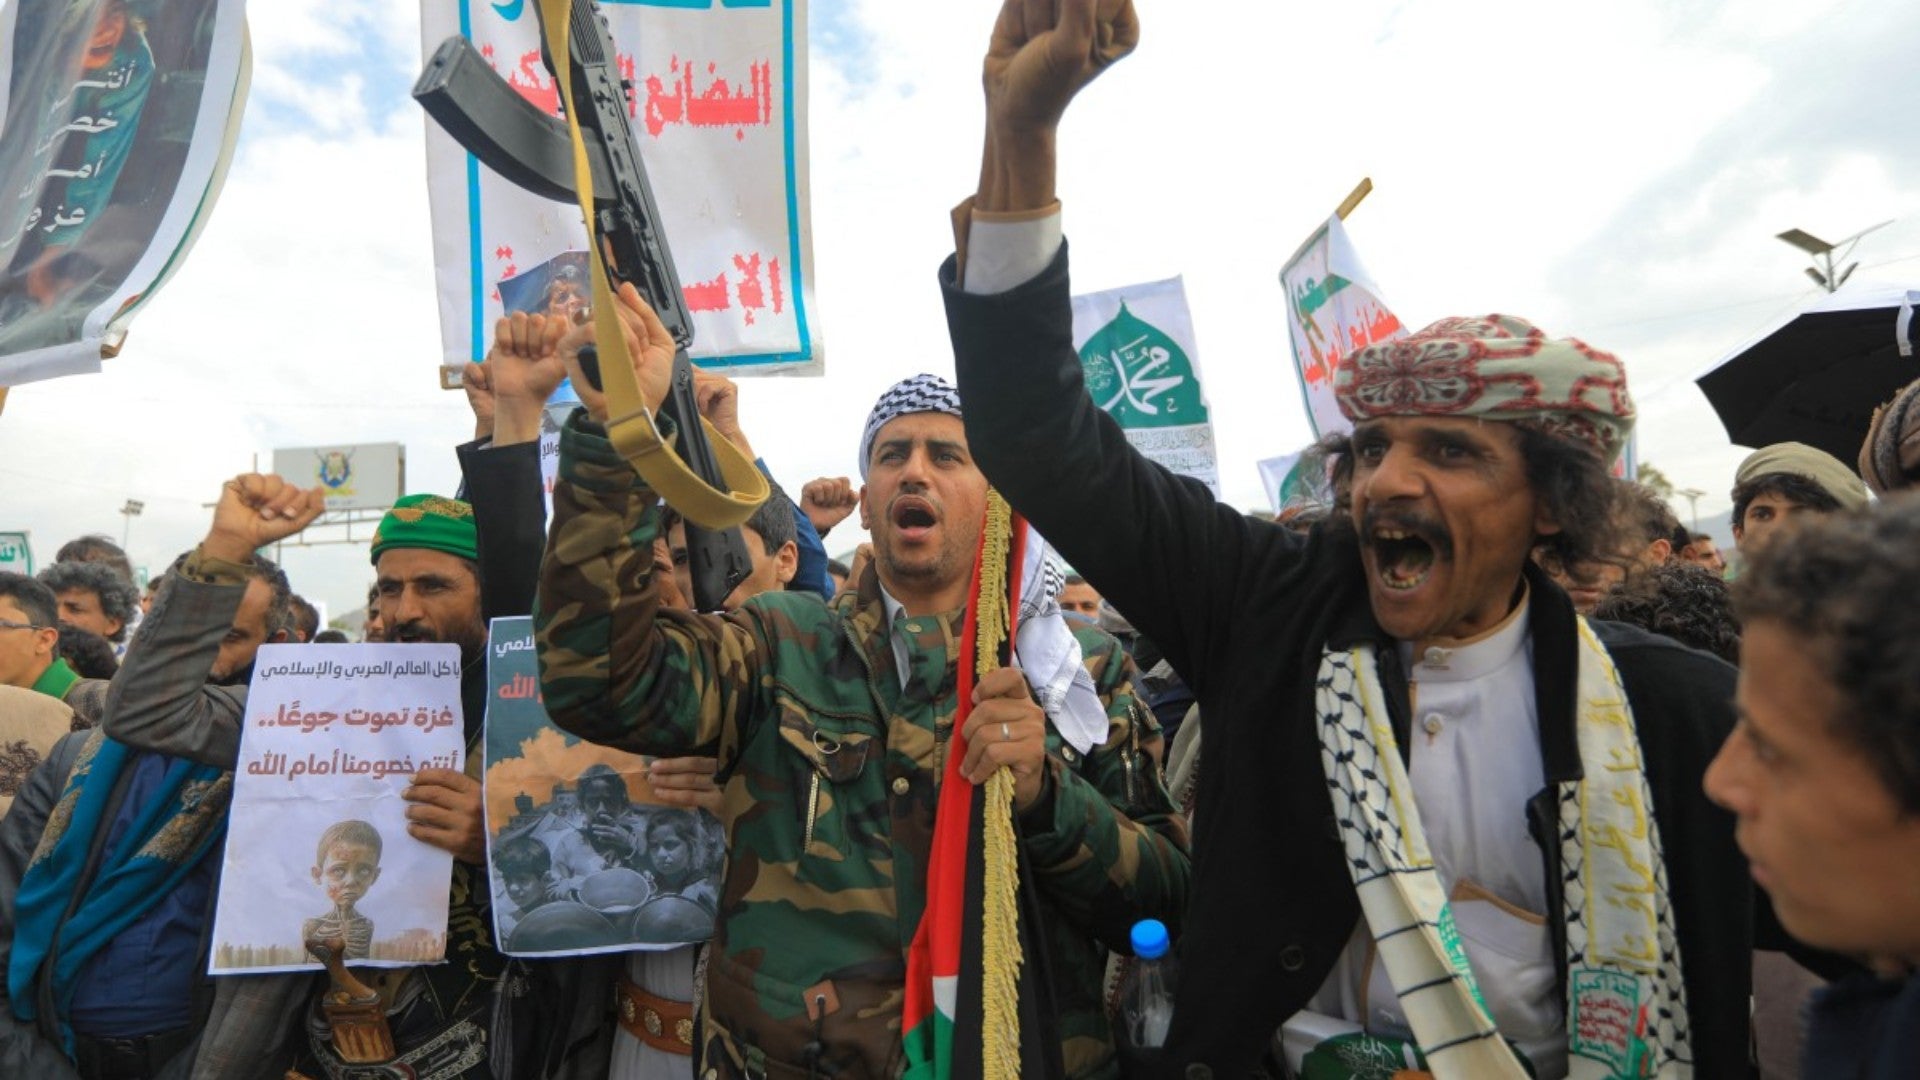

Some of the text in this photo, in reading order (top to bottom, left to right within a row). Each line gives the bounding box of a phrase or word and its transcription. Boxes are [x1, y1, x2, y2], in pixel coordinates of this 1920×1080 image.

[645, 54, 772, 141] البضائع
[260, 660, 342, 681] والإسلامي
[345, 660, 392, 680] العربي
[393, 660, 430, 679] العالم
[432, 660, 450, 678] كل
[498, 671, 536, 699] الله
[344, 707, 410, 733] تموت
[413, 705, 454, 733] غزة
[247, 749, 287, 775] الله
[288, 748, 340, 781] أمام
[342, 753, 416, 780] خصومنا
